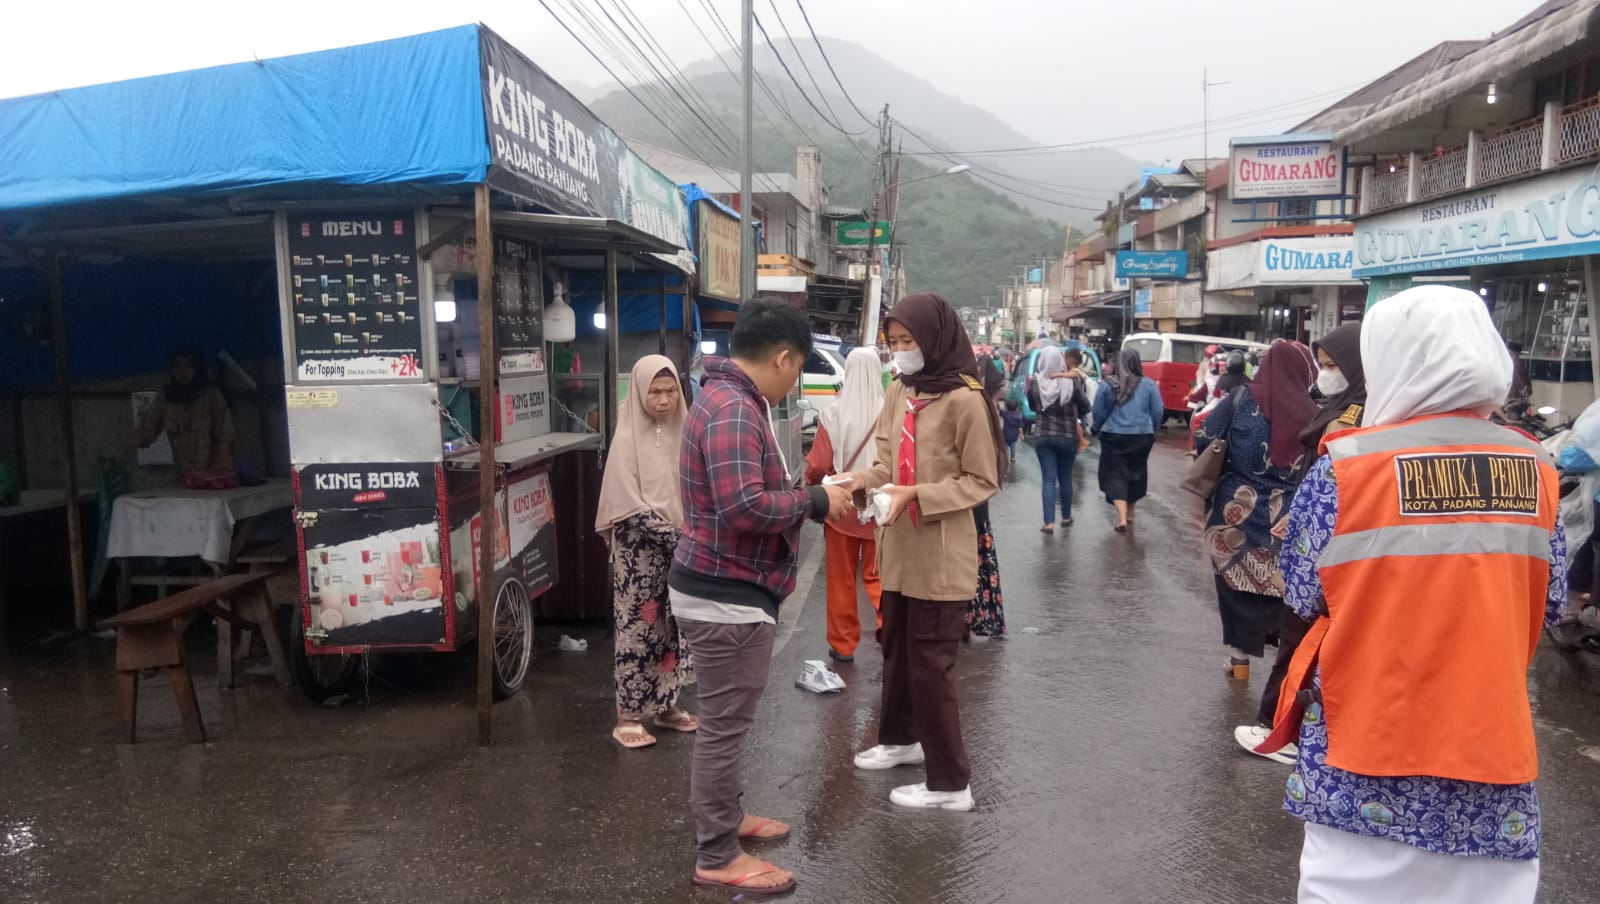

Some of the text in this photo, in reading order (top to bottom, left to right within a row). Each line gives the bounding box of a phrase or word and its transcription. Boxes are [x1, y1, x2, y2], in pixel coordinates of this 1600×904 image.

[488, 65, 600, 184] KING BOBA
[1257, 146, 1320, 159] RESTAURANT
[496, 134, 588, 203] PADANG PANJANG
[1240, 153, 1337, 183] GUMARANG
[1421, 194, 1497, 222] RESTAURANT
[322, 220, 382, 237] MENU
[305, 363, 317, 376] For
[318, 362, 345, 377] Topping
[512, 393, 529, 410] KING
[315, 471, 420, 490] KING BOBA
[1402, 457, 1537, 499] PRAMUKA PEDULI
[513, 494, 530, 515] KING
[1405, 499, 1536, 511] KOTA PADANG PANJANG
